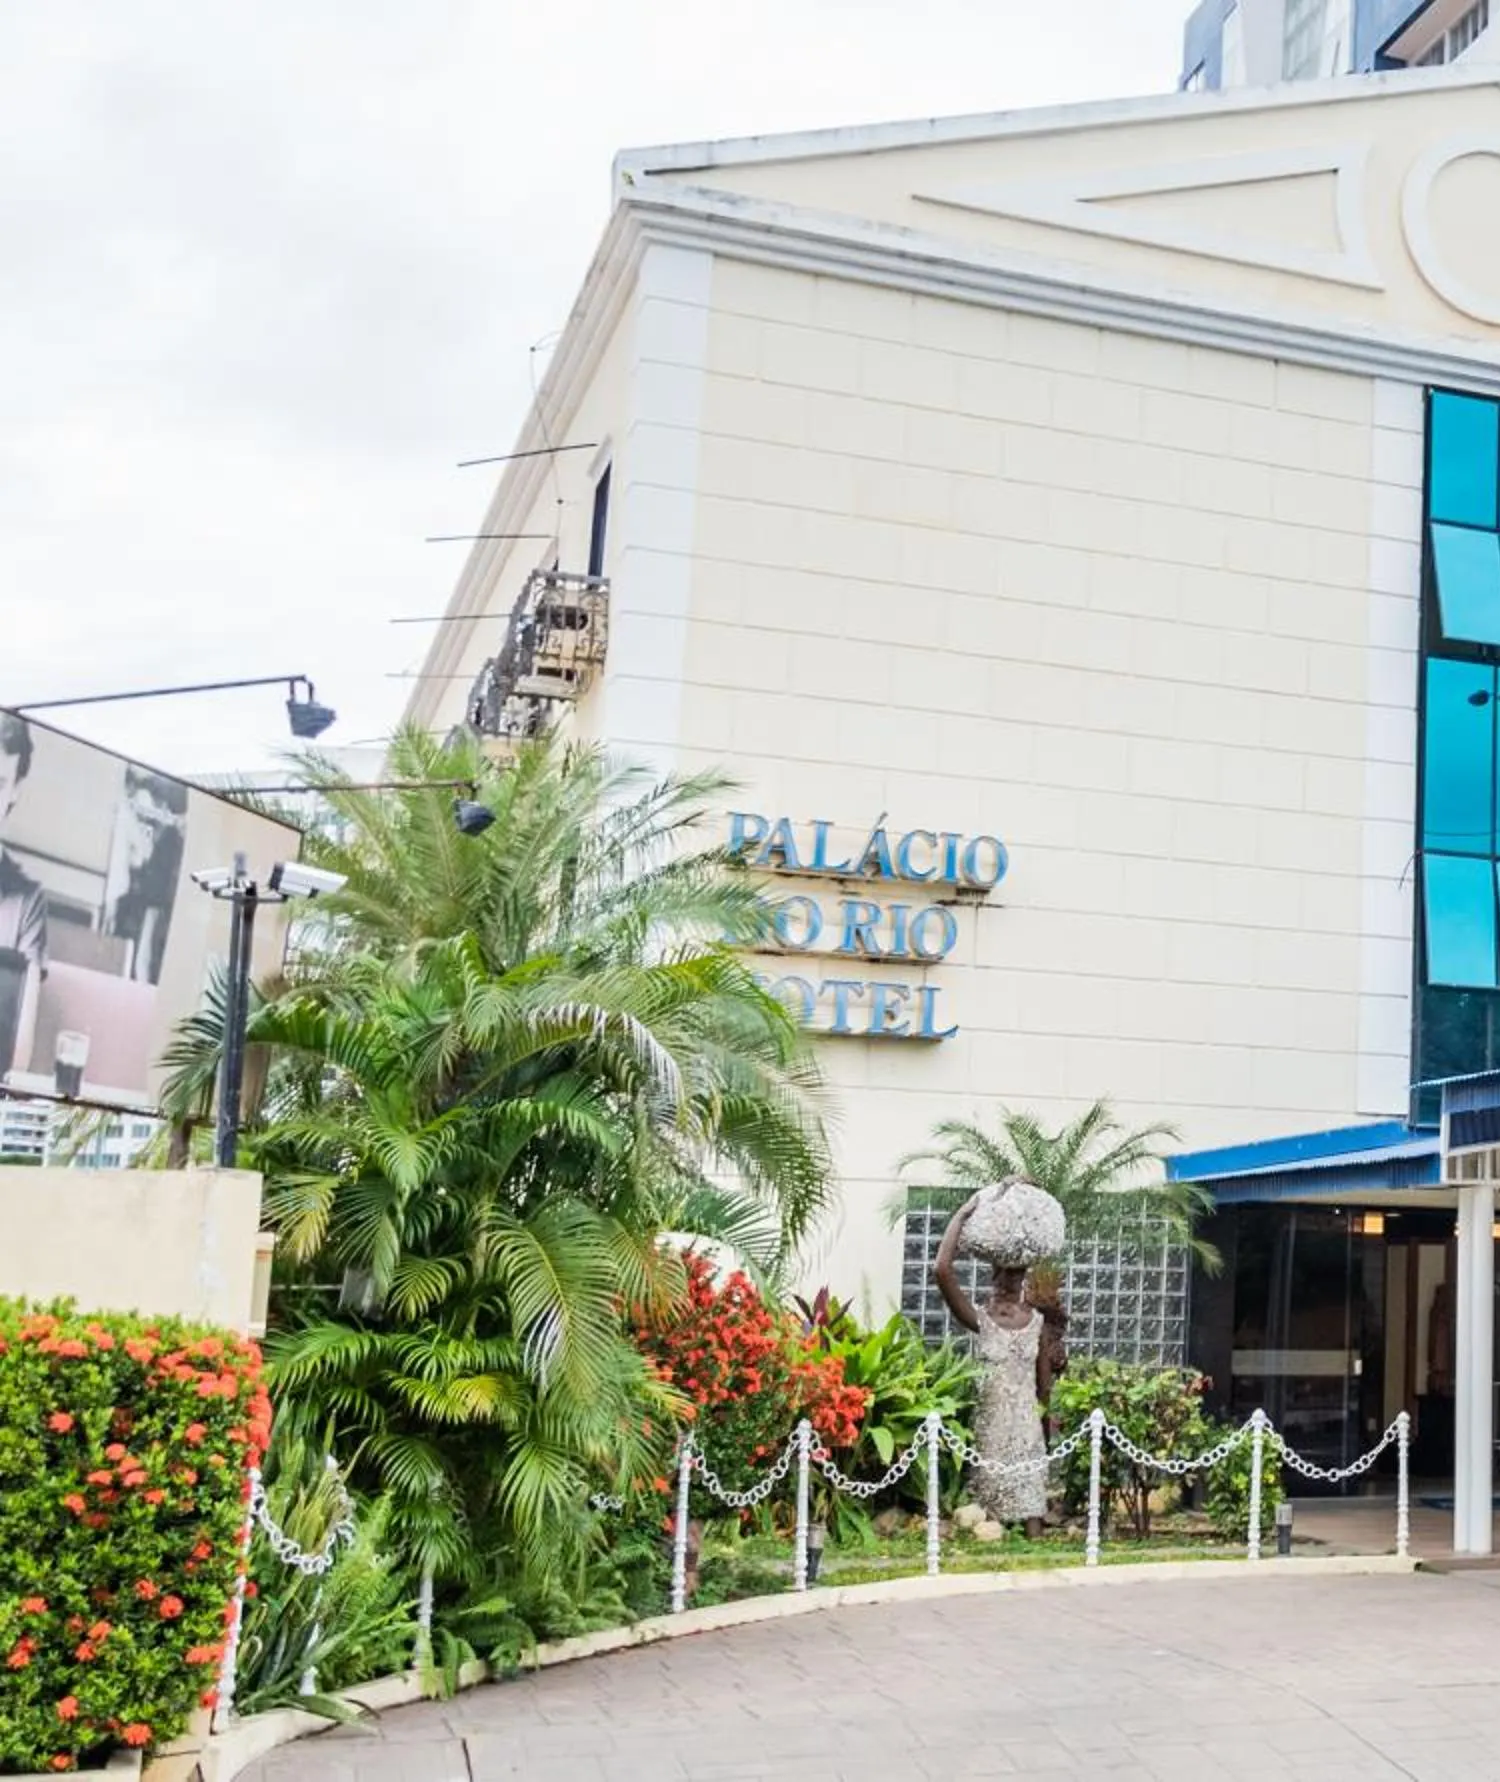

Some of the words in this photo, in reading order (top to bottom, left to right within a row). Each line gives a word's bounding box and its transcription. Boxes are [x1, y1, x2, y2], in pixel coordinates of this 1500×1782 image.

[727, 811, 1010, 888] PALÁCIO
[723, 895, 823, 951] O
[836, 899, 959, 961] RIO
[751, 975, 960, 1039] OTEL
